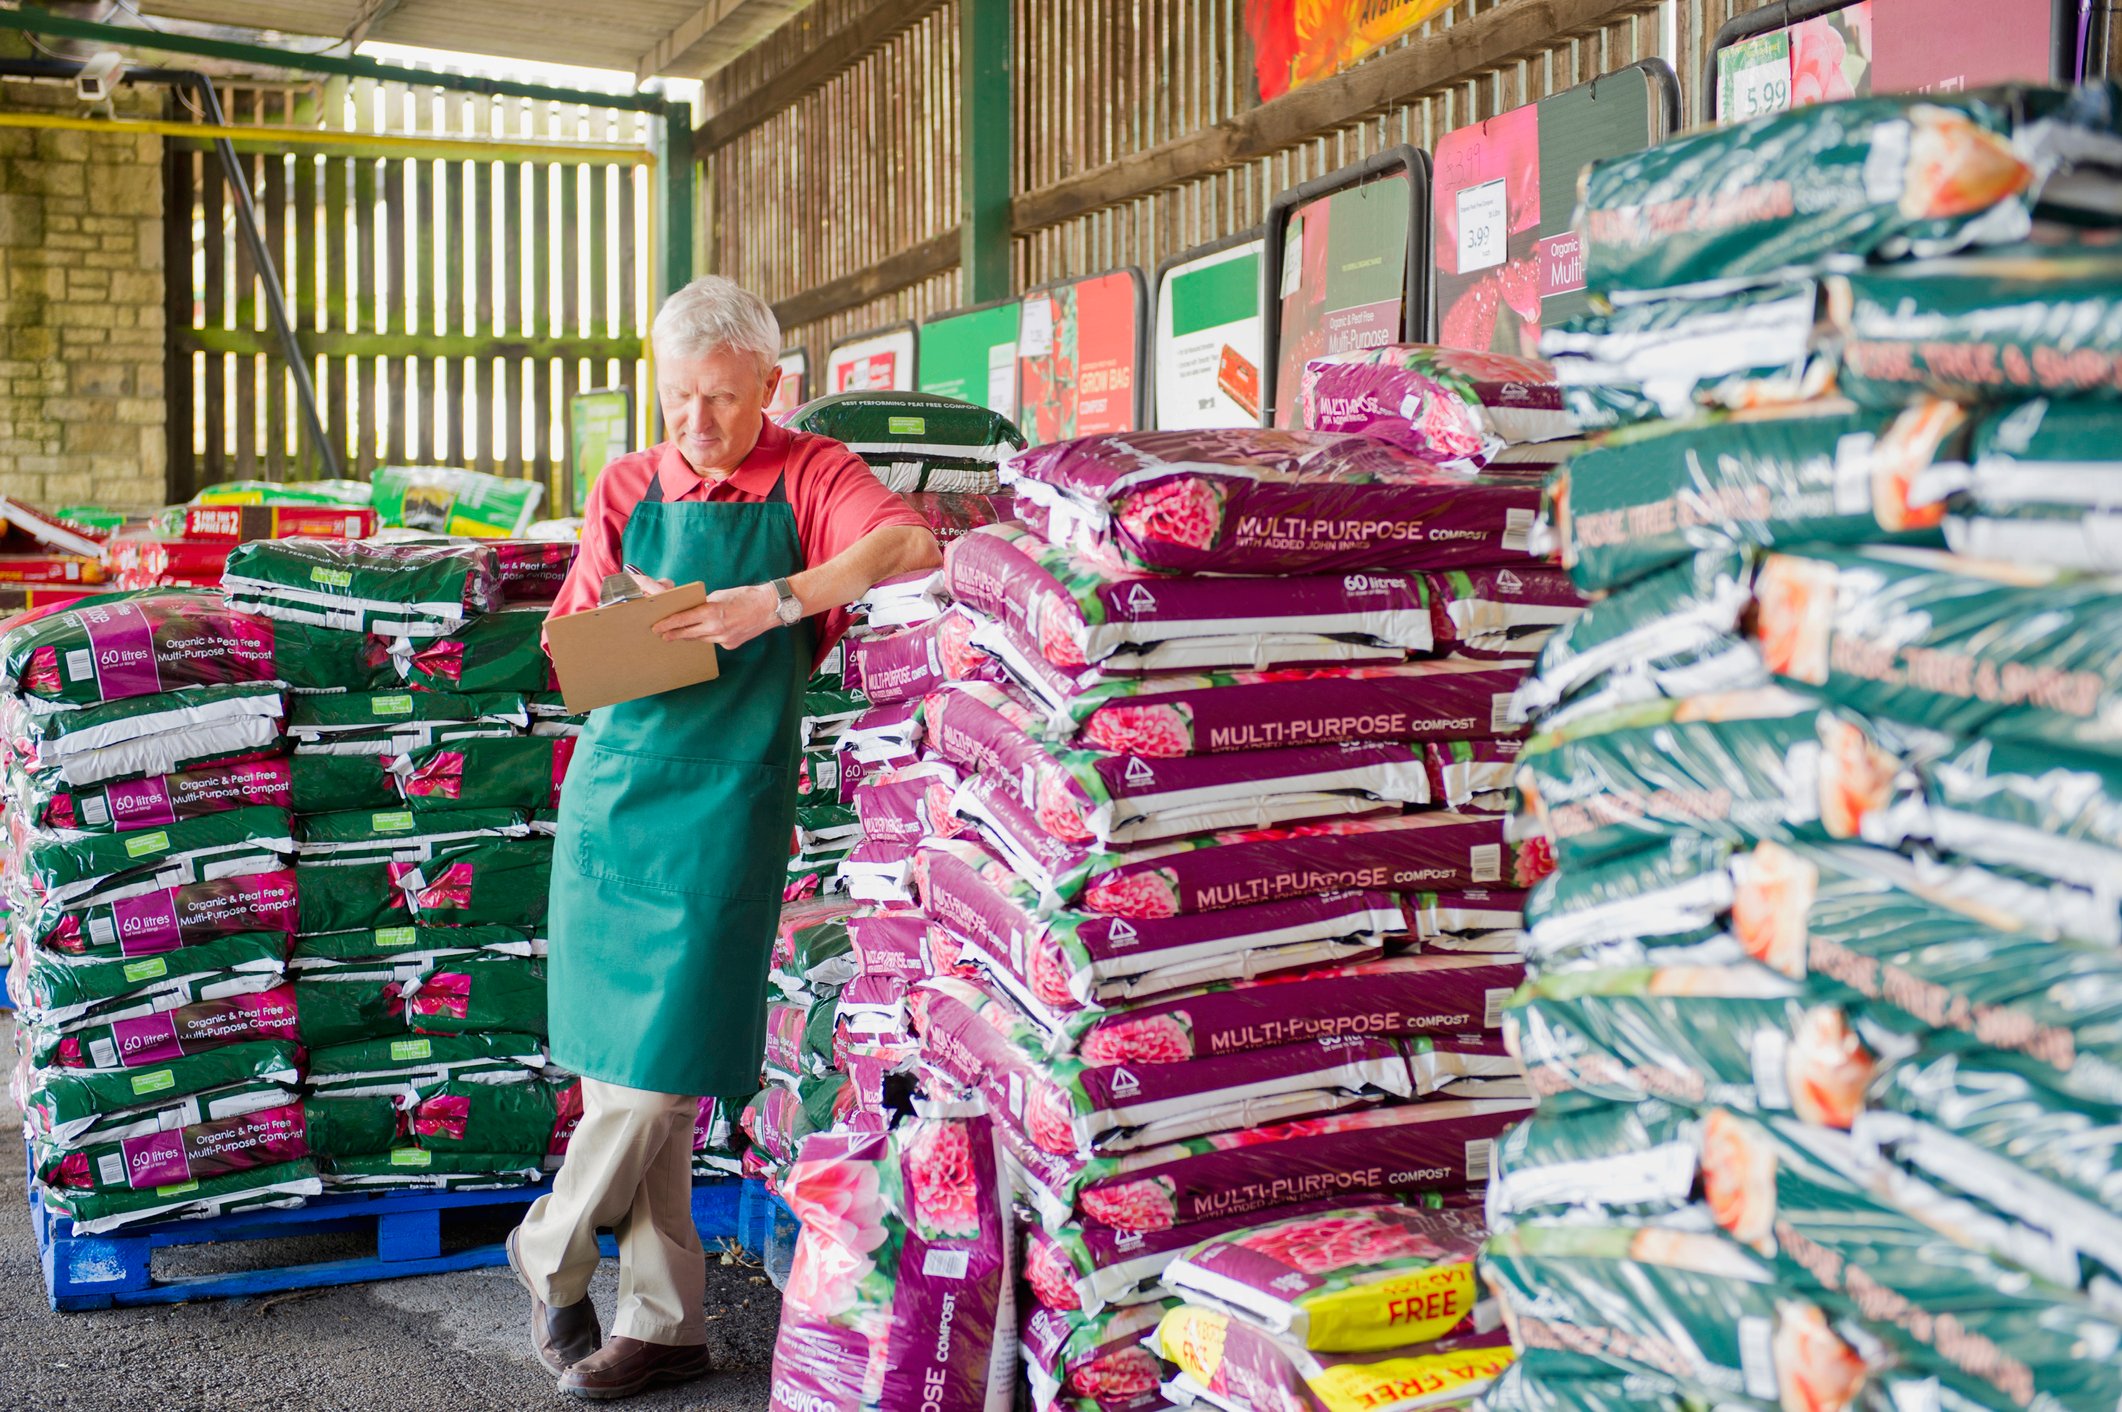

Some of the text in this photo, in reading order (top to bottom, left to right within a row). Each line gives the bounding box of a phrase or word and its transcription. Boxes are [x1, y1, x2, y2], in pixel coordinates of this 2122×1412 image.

[1747, 78, 1787, 117] 5.99
[1468, 225, 1490, 248] 3.99
[1551, 241, 1578, 257] Organic
[1329, 327, 1389, 354] Multi-Purpose
[1081, 367, 1130, 394] GROW BAG
[192, 511, 201, 534] 3
[230, 511, 238, 535] 2
[1236, 515, 1490, 542] MULTI-PURPOSE COMPOST
[1264, 538, 1305, 550] ADDED
[1306, 540, 1337, 550] JOHN
[512, 562, 518, 570] &
[520, 561, 540, 570] Peat
[1344, 574, 1407, 591] 60 litres
[157, 648, 272, 662] Multi-Purpose Compost
[166, 637, 261, 649] Organic & Peat Free
[101, 648, 148, 664] 60 litres
[1210, 714, 1477, 747] MULTI-PURPOSE COMPOST
[180, 771, 277, 790] Organic & Peat Free
[845, 765, 860, 777] 60
[115, 793, 163, 810] 60 litres
[172, 781, 289, 805] Multi-Purpose Compost
[1196, 867, 1387, 908] MULTI-PURPOSE
[1394, 868, 1457, 883] COMPOST
[188, 888, 285, 912] Organic & Peat Free
[123, 914, 170, 933] 60 litres
[180, 898, 297, 927] Multi-Purpose Compost
[180, 1014, 296, 1040] Multi-Purpose Compost
[187, 1006, 284, 1029] Organic & Peat Free
[124, 1031, 170, 1051] 60 litres
[1211, 1012, 1470, 1051] MULTI-PURPOSE COMPOST
[188, 1129, 303, 1160] Multi-Purpose Compost
[196, 1119, 292, 1146] Organic & Peat Free
[132, 1148, 178, 1168] 60 litres
[1194, 1167, 1452, 1214] MULTI-PURPOSE COMPOST
[1388, 1290, 1457, 1326] FREE
[937, 1292, 956, 1362] COMPOST
[1356, 1375, 1444, 1410] FREE
